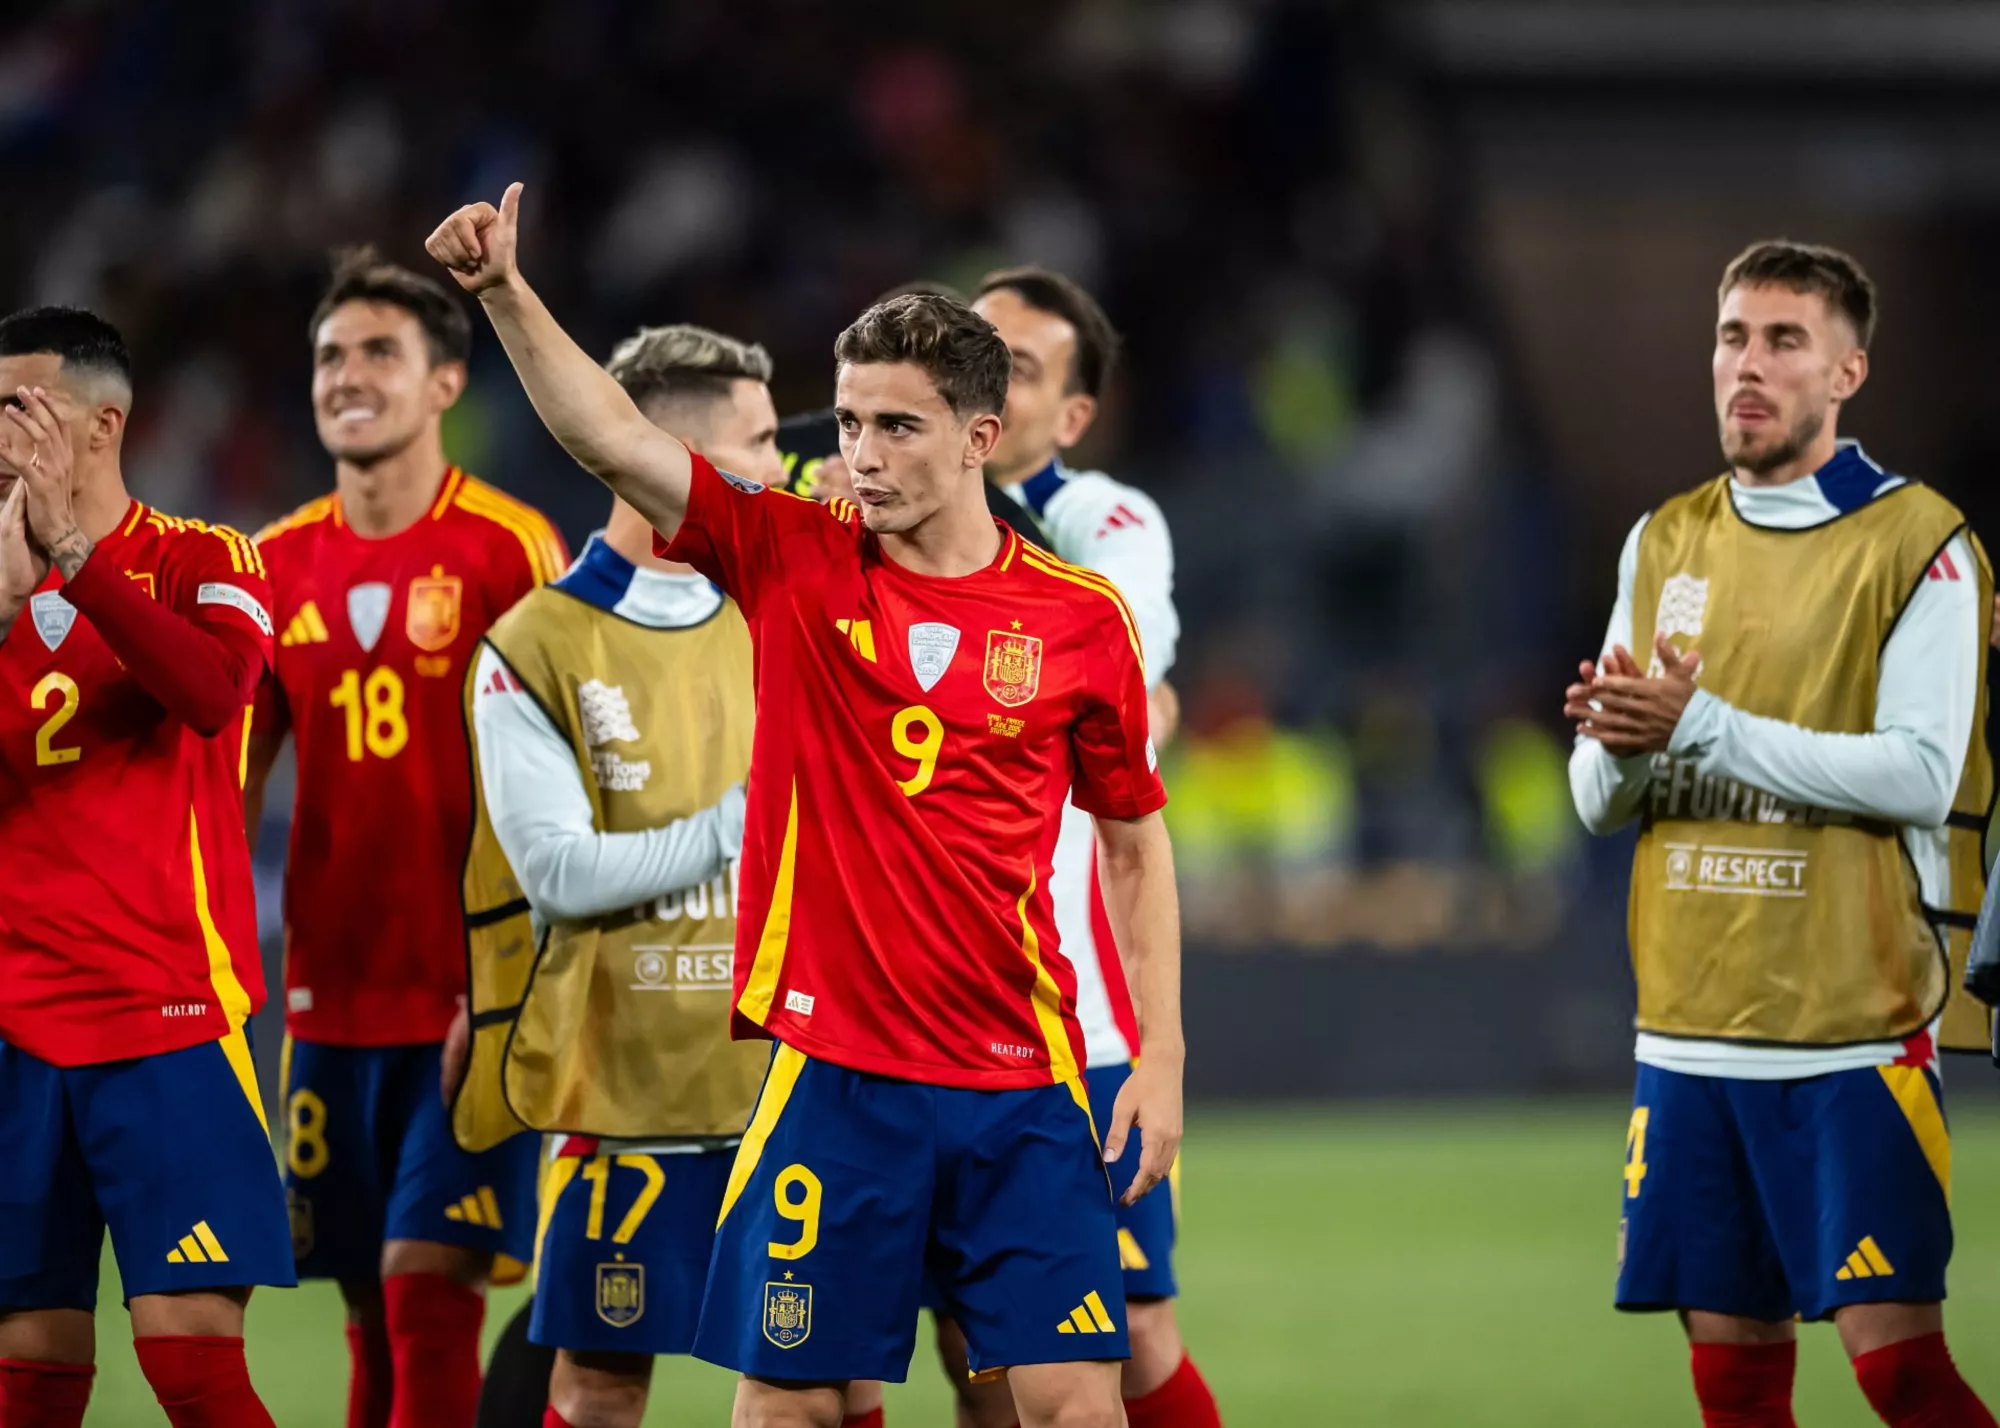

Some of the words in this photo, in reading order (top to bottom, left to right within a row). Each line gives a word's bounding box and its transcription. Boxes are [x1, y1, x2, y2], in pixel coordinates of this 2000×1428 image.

[31, 671, 81, 766] 2
[330, 664, 409, 762] 18
[891, 705, 945, 797] 9
[1699, 854, 1807, 887] RESPECT
[162, 1004, 206, 1017] HEAT.RDY
[676, 953, 734, 981] RES
[991, 1042, 1034, 1059] HEAT.RDY
[289, 1088, 329, 1178] 8
[582, 1154, 666, 1244] 17
[768, 1163, 823, 1260] 9
